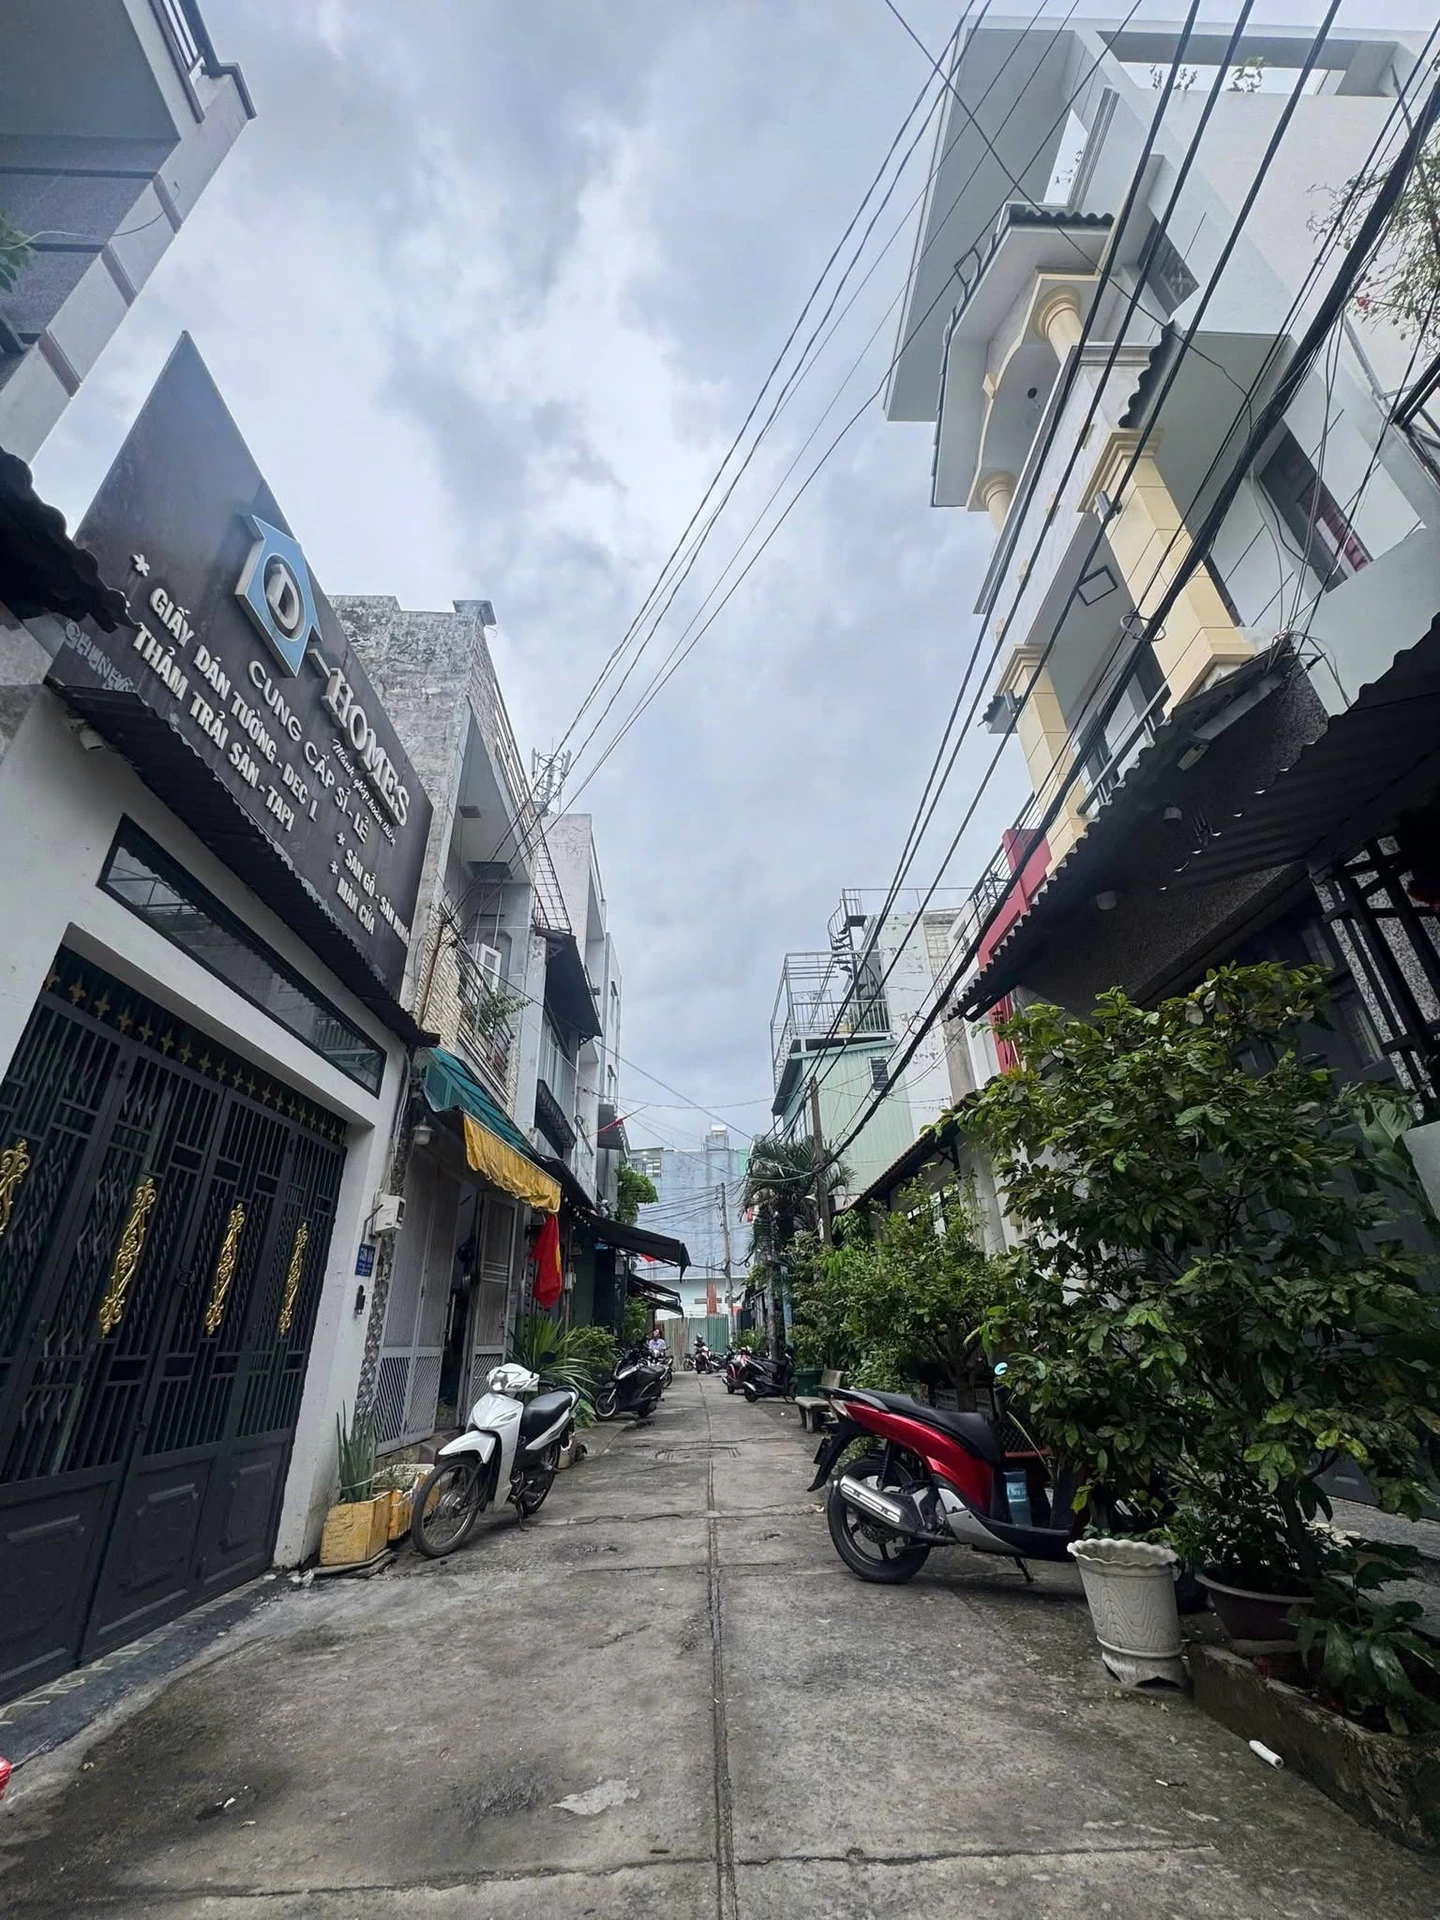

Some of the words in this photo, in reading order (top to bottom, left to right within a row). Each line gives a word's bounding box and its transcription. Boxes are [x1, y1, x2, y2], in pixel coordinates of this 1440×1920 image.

[132, 621, 189, 701] THẢM
[189, 690, 229, 750] TRẢI
[227, 741, 260, 788] SÀN
[265, 785, 295, 832] TAPI
[149, 588, 195, 648] GIẤY
[193, 644, 232, 701] DÁN
[230, 690, 277, 764] TƯỜNG
[249, 660, 302, 741] CUNG
[303, 741, 335, 788] CẤP
[320, 667, 411, 828] HOMES
[336, 876, 360, 914] MÀN
[344, 848, 364, 883] SÀN
